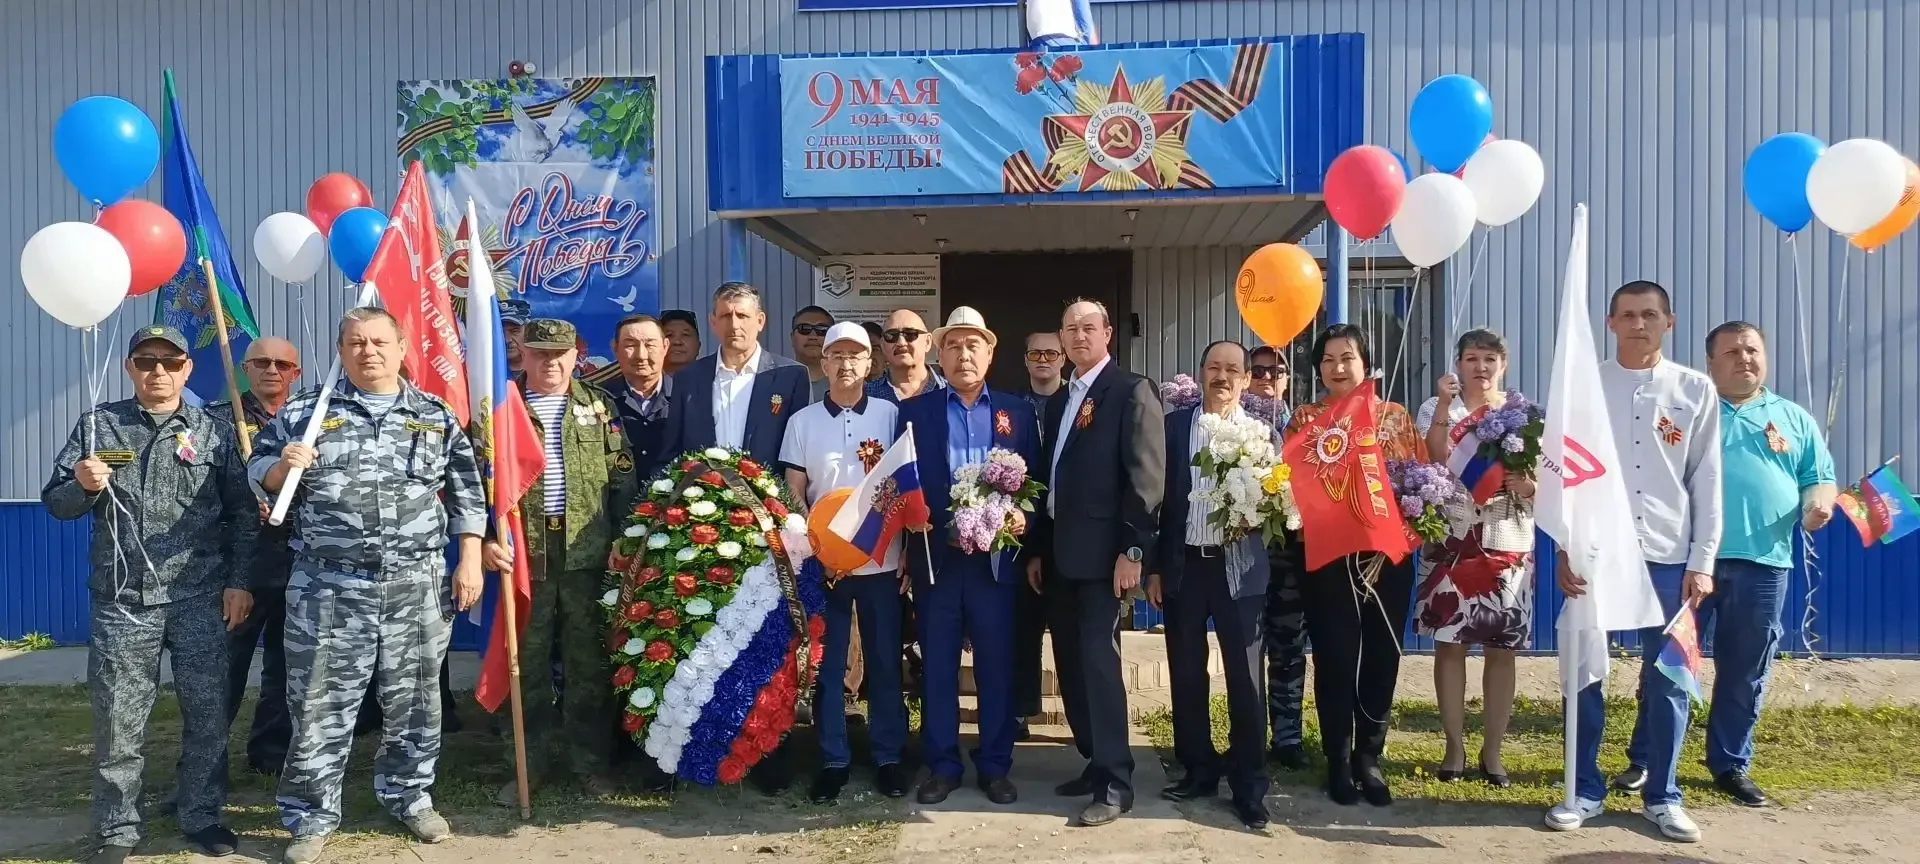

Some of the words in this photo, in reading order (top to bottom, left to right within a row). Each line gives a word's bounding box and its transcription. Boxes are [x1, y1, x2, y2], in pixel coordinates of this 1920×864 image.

[807, 70, 845, 129] 9
[848, 78, 941, 106] МАЯ
[849, 112, 941, 128] 1941-1945
[806, 135, 816, 147] С
[818, 134, 863, 148] ДНЕМ
[866, 131, 941, 147] ВЕЛИКОЙ
[1087, 104, 1147, 163] ОТЕЧЕСТВЕННАЯ
[1133, 125, 1153, 163] ВОЙНА
[803, 148, 943, 173] ПОБЕДЫ!
[503, 186, 535, 248] С
[1238, 268, 1256, 309] 9
